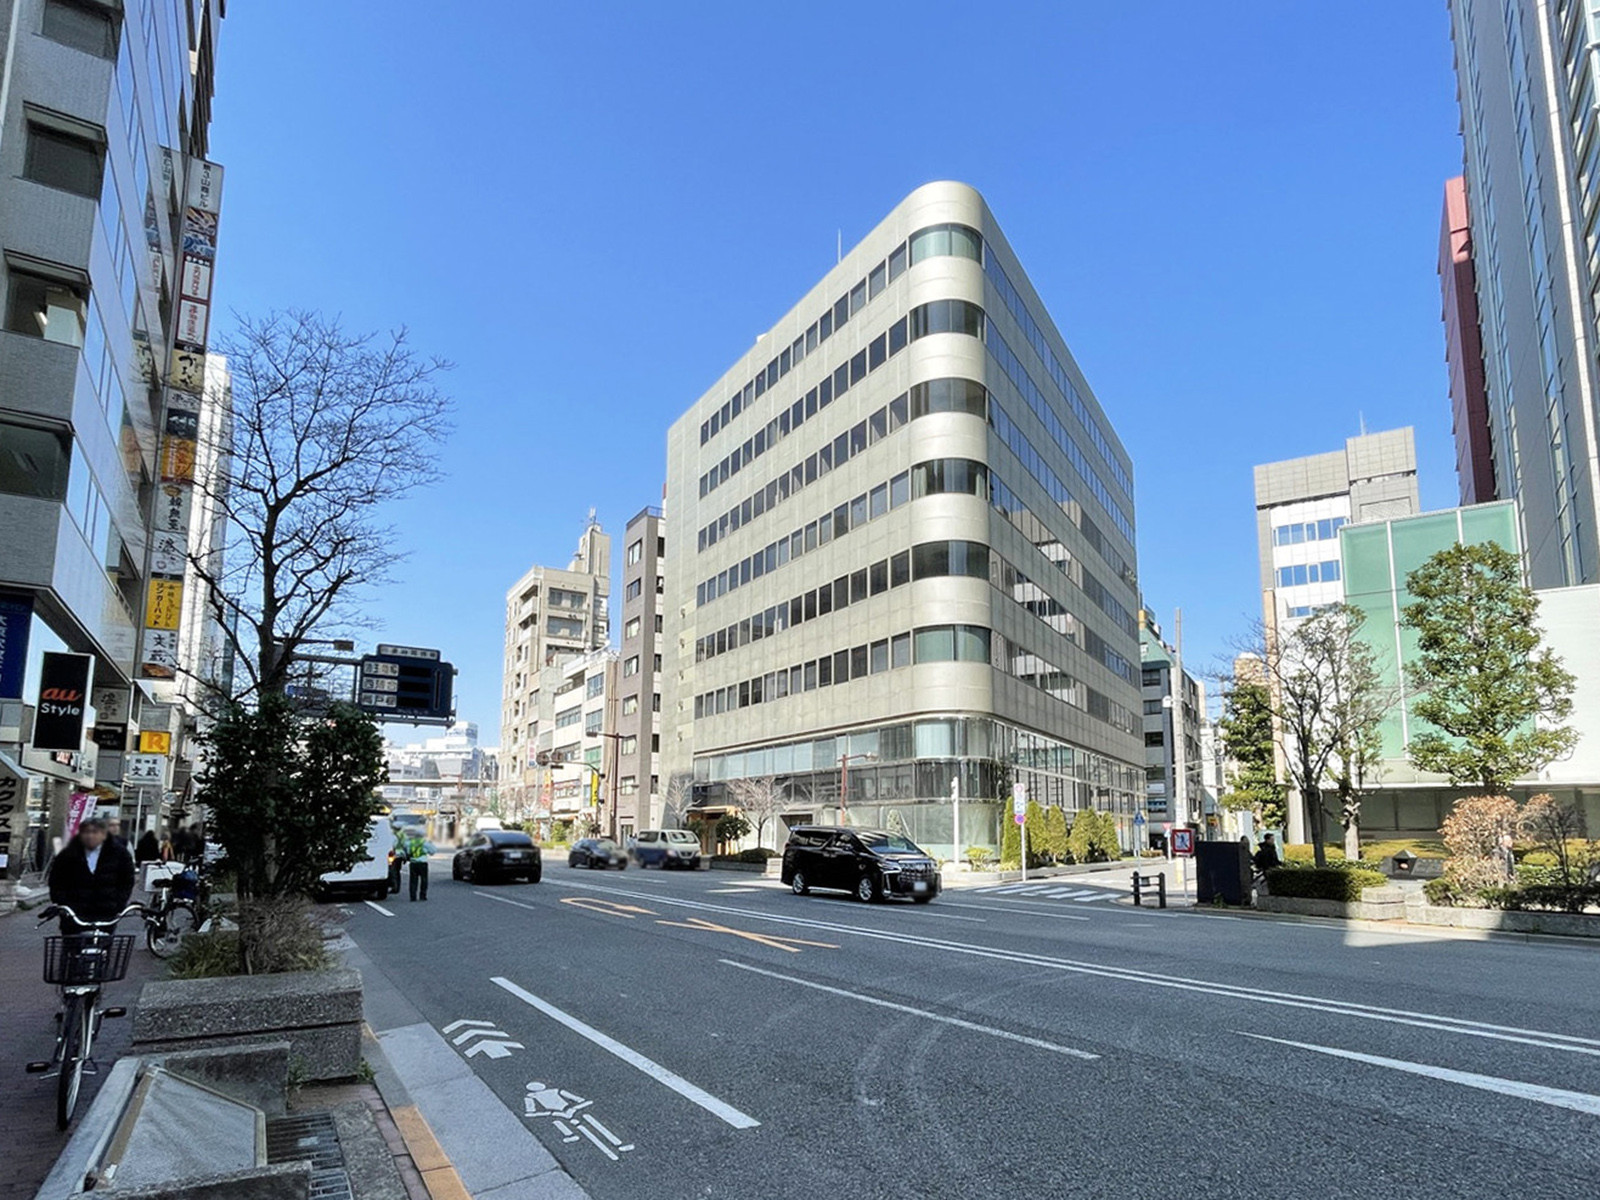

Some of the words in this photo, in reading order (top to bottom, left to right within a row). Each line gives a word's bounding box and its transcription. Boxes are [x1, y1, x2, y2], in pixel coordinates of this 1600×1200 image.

[153, 582, 164, 626] リンガーハット
[42, 687, 83, 702] au
[40, 703, 81, 717] Style
